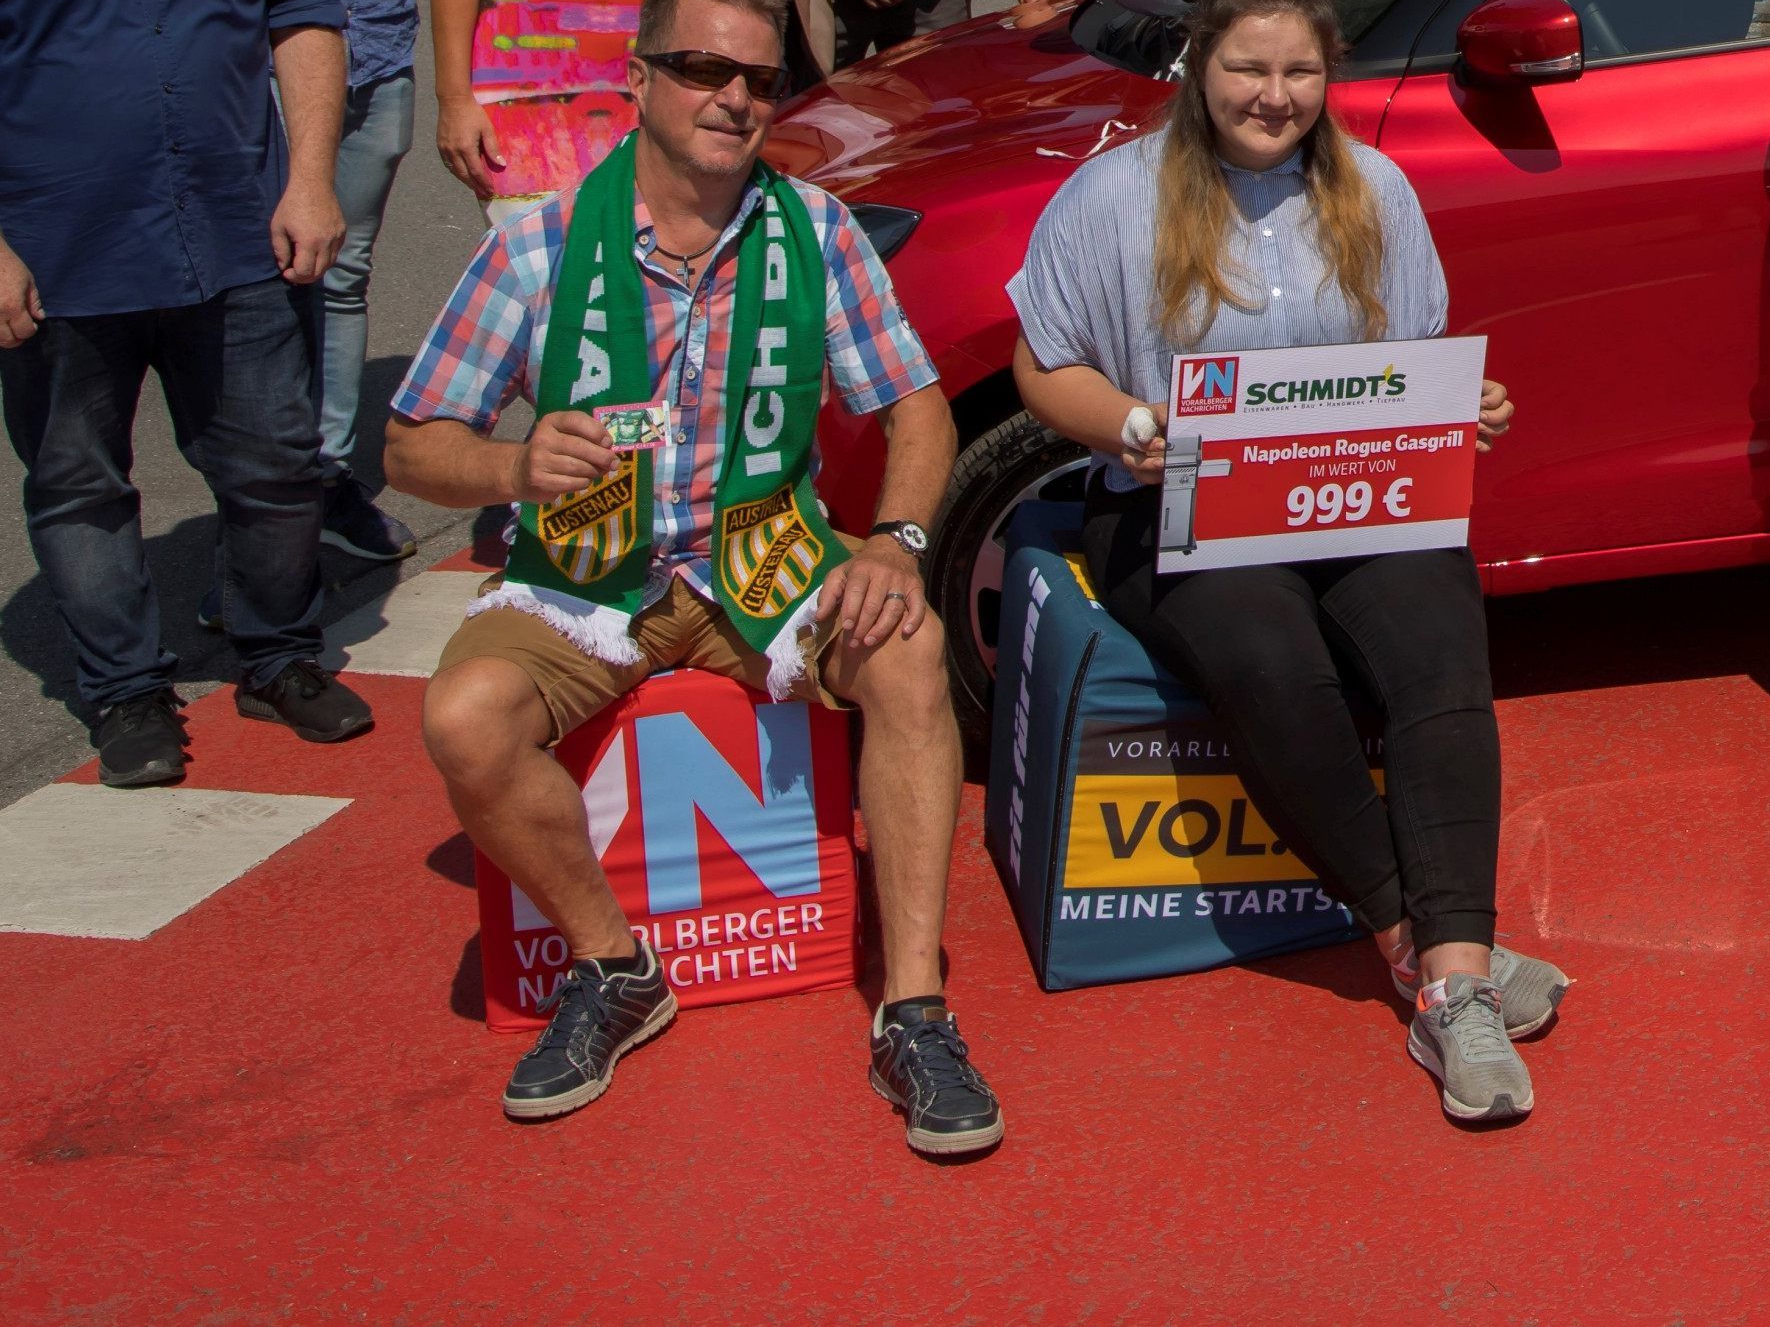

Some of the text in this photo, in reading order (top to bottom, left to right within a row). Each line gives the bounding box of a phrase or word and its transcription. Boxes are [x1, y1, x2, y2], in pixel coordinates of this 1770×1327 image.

[1182, 360, 1236, 400] VN
[743, 326, 788, 477] ICH
[1180, 395, 1234, 407] VORARLBERGER
[1180, 404, 1228, 414] NACHRICHTEN
[1243, 405, 1290, 414] EISENWAREN
[1326, 400, 1365, 408] HANDWERK
[1243, 430, 1464, 464] Napoleon Rogue Gasgrill
[1309, 458, 1397, 479] IM WERT VON
[546, 481, 631, 538] LUSTENAU
[728, 491, 787, 531] AUSTRIA
[1287, 477, 1413, 527] 999 €
[744, 527, 806, 614] LUSTENAU
[1099, 797, 1297, 860] VOL.
[1060, 891, 1181, 920] MEINE
[514, 902, 825, 970] VOLBERGER
[518, 941, 798, 1007] NCHTEN
